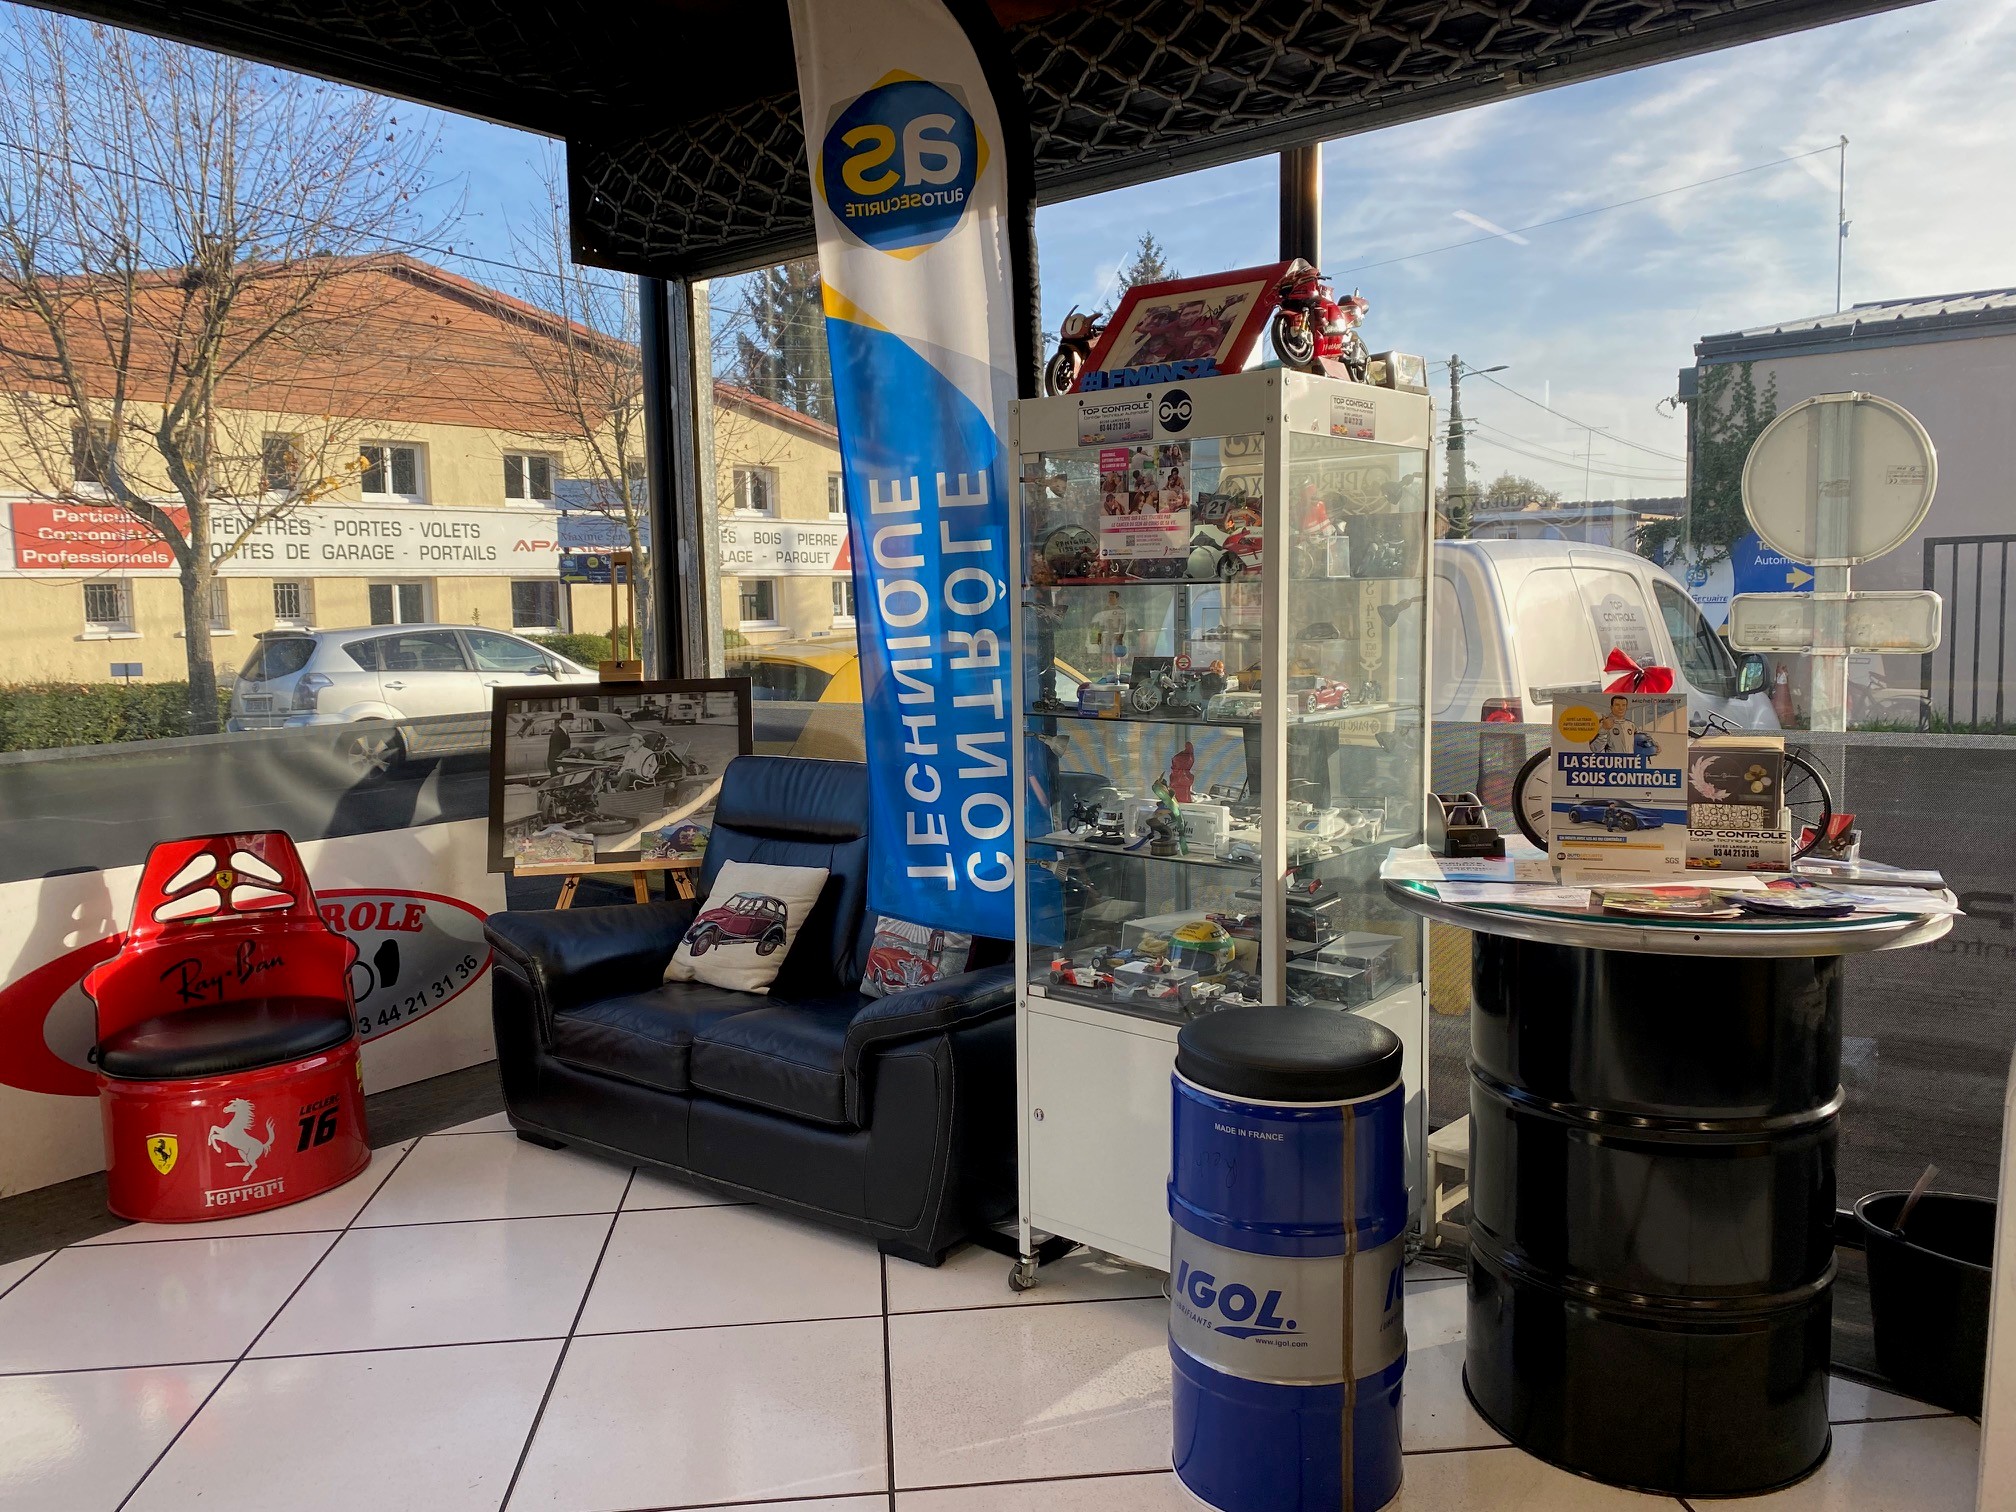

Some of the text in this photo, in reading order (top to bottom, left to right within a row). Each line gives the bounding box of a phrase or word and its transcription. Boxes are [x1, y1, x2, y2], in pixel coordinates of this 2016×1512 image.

[1083, 402, 1149, 416] TOP CONTROLE
[1207, 501, 1227, 514] 21
[334, 520, 402, 537] PORTES
[420, 522, 481, 538] VOLETS
[753, 531, 782, 545] BOIS
[797, 533, 838, 546] PIERRE
[22, 549, 168, 564] Professionnels
[211, 542, 275, 561] ORTES
[286, 543, 310, 560] DE
[322, 544, 395, 560] GARAGE
[420, 545, 497, 561] PORTAILS
[775, 551, 830, 563] PARQUET
[1563, 753, 1642, 769] LA SÉCURITÉ
[1571, 770, 1677, 786] SOUS CONTRÔLE
[1716, 831, 1787, 840] CONTROLE
[1723, 849, 1732, 857] 44
[1733, 849, 1740, 857] 21
[1750, 850, 1760, 858] 36
[320, 902, 426, 932] ROLE
[358, 954, 478, 1034] 3 44 21 31 36
[296, 1106, 340, 1153] 16
[1214, 1123, 1284, 1141] MADE IN FRANCE
[205, 1177, 285, 1208] Ferrari
[1255, 1337, 1308, 1348] www.igol.com
